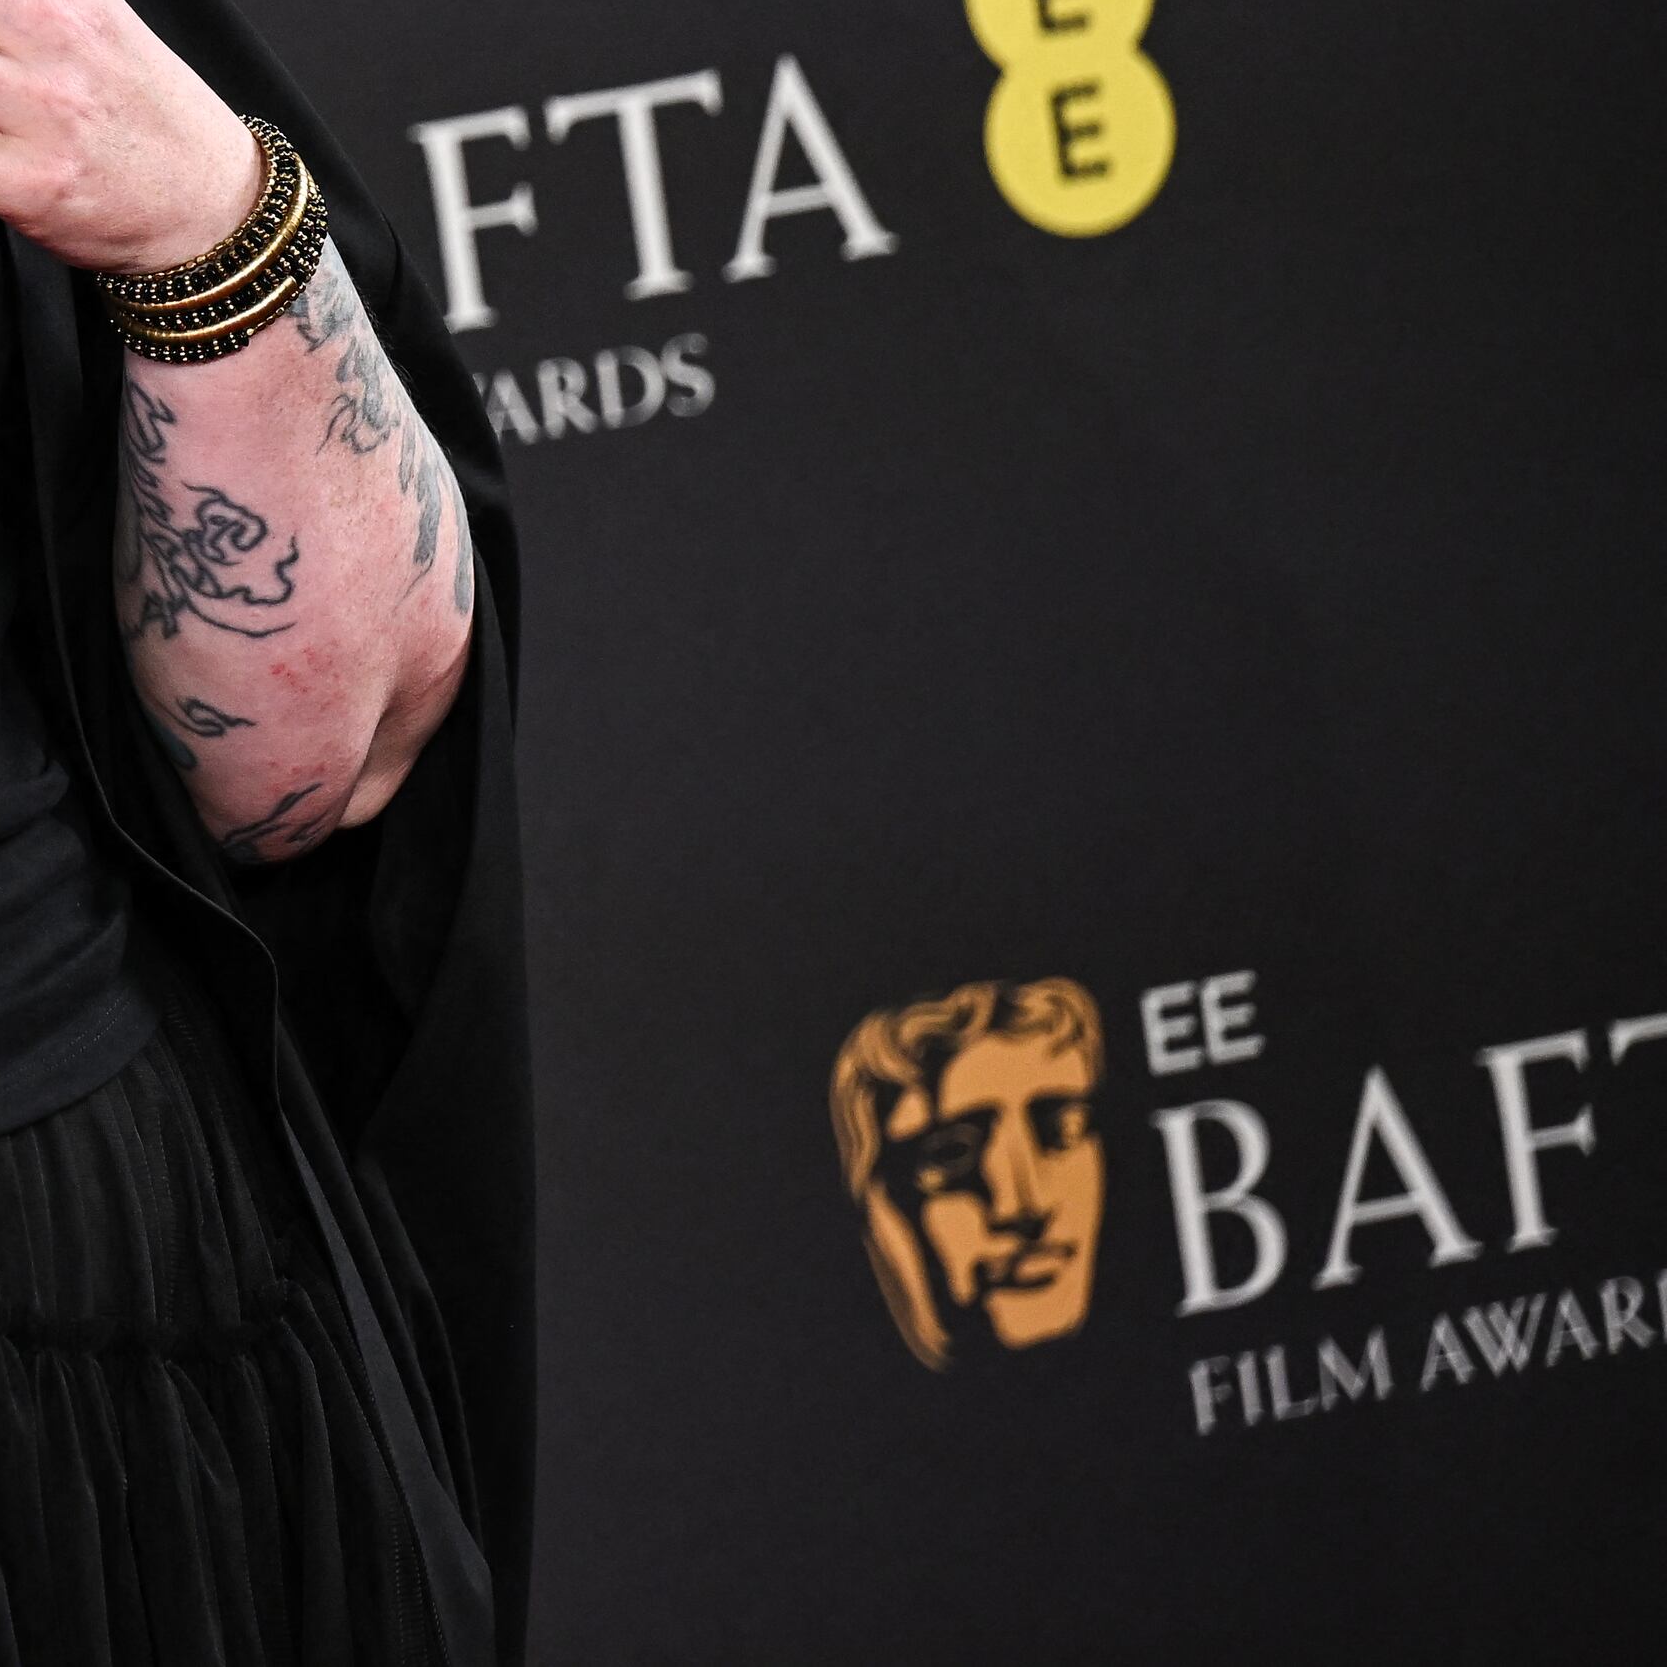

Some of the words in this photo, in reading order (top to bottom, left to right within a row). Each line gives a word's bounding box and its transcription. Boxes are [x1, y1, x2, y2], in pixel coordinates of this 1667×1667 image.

[410, 54, 895, 334] FTA
[1141, 971, 1262, 1074] EE
[1189, 1330, 1393, 1434] FILM
[1421, 1269, 1667, 1391] AWAR
